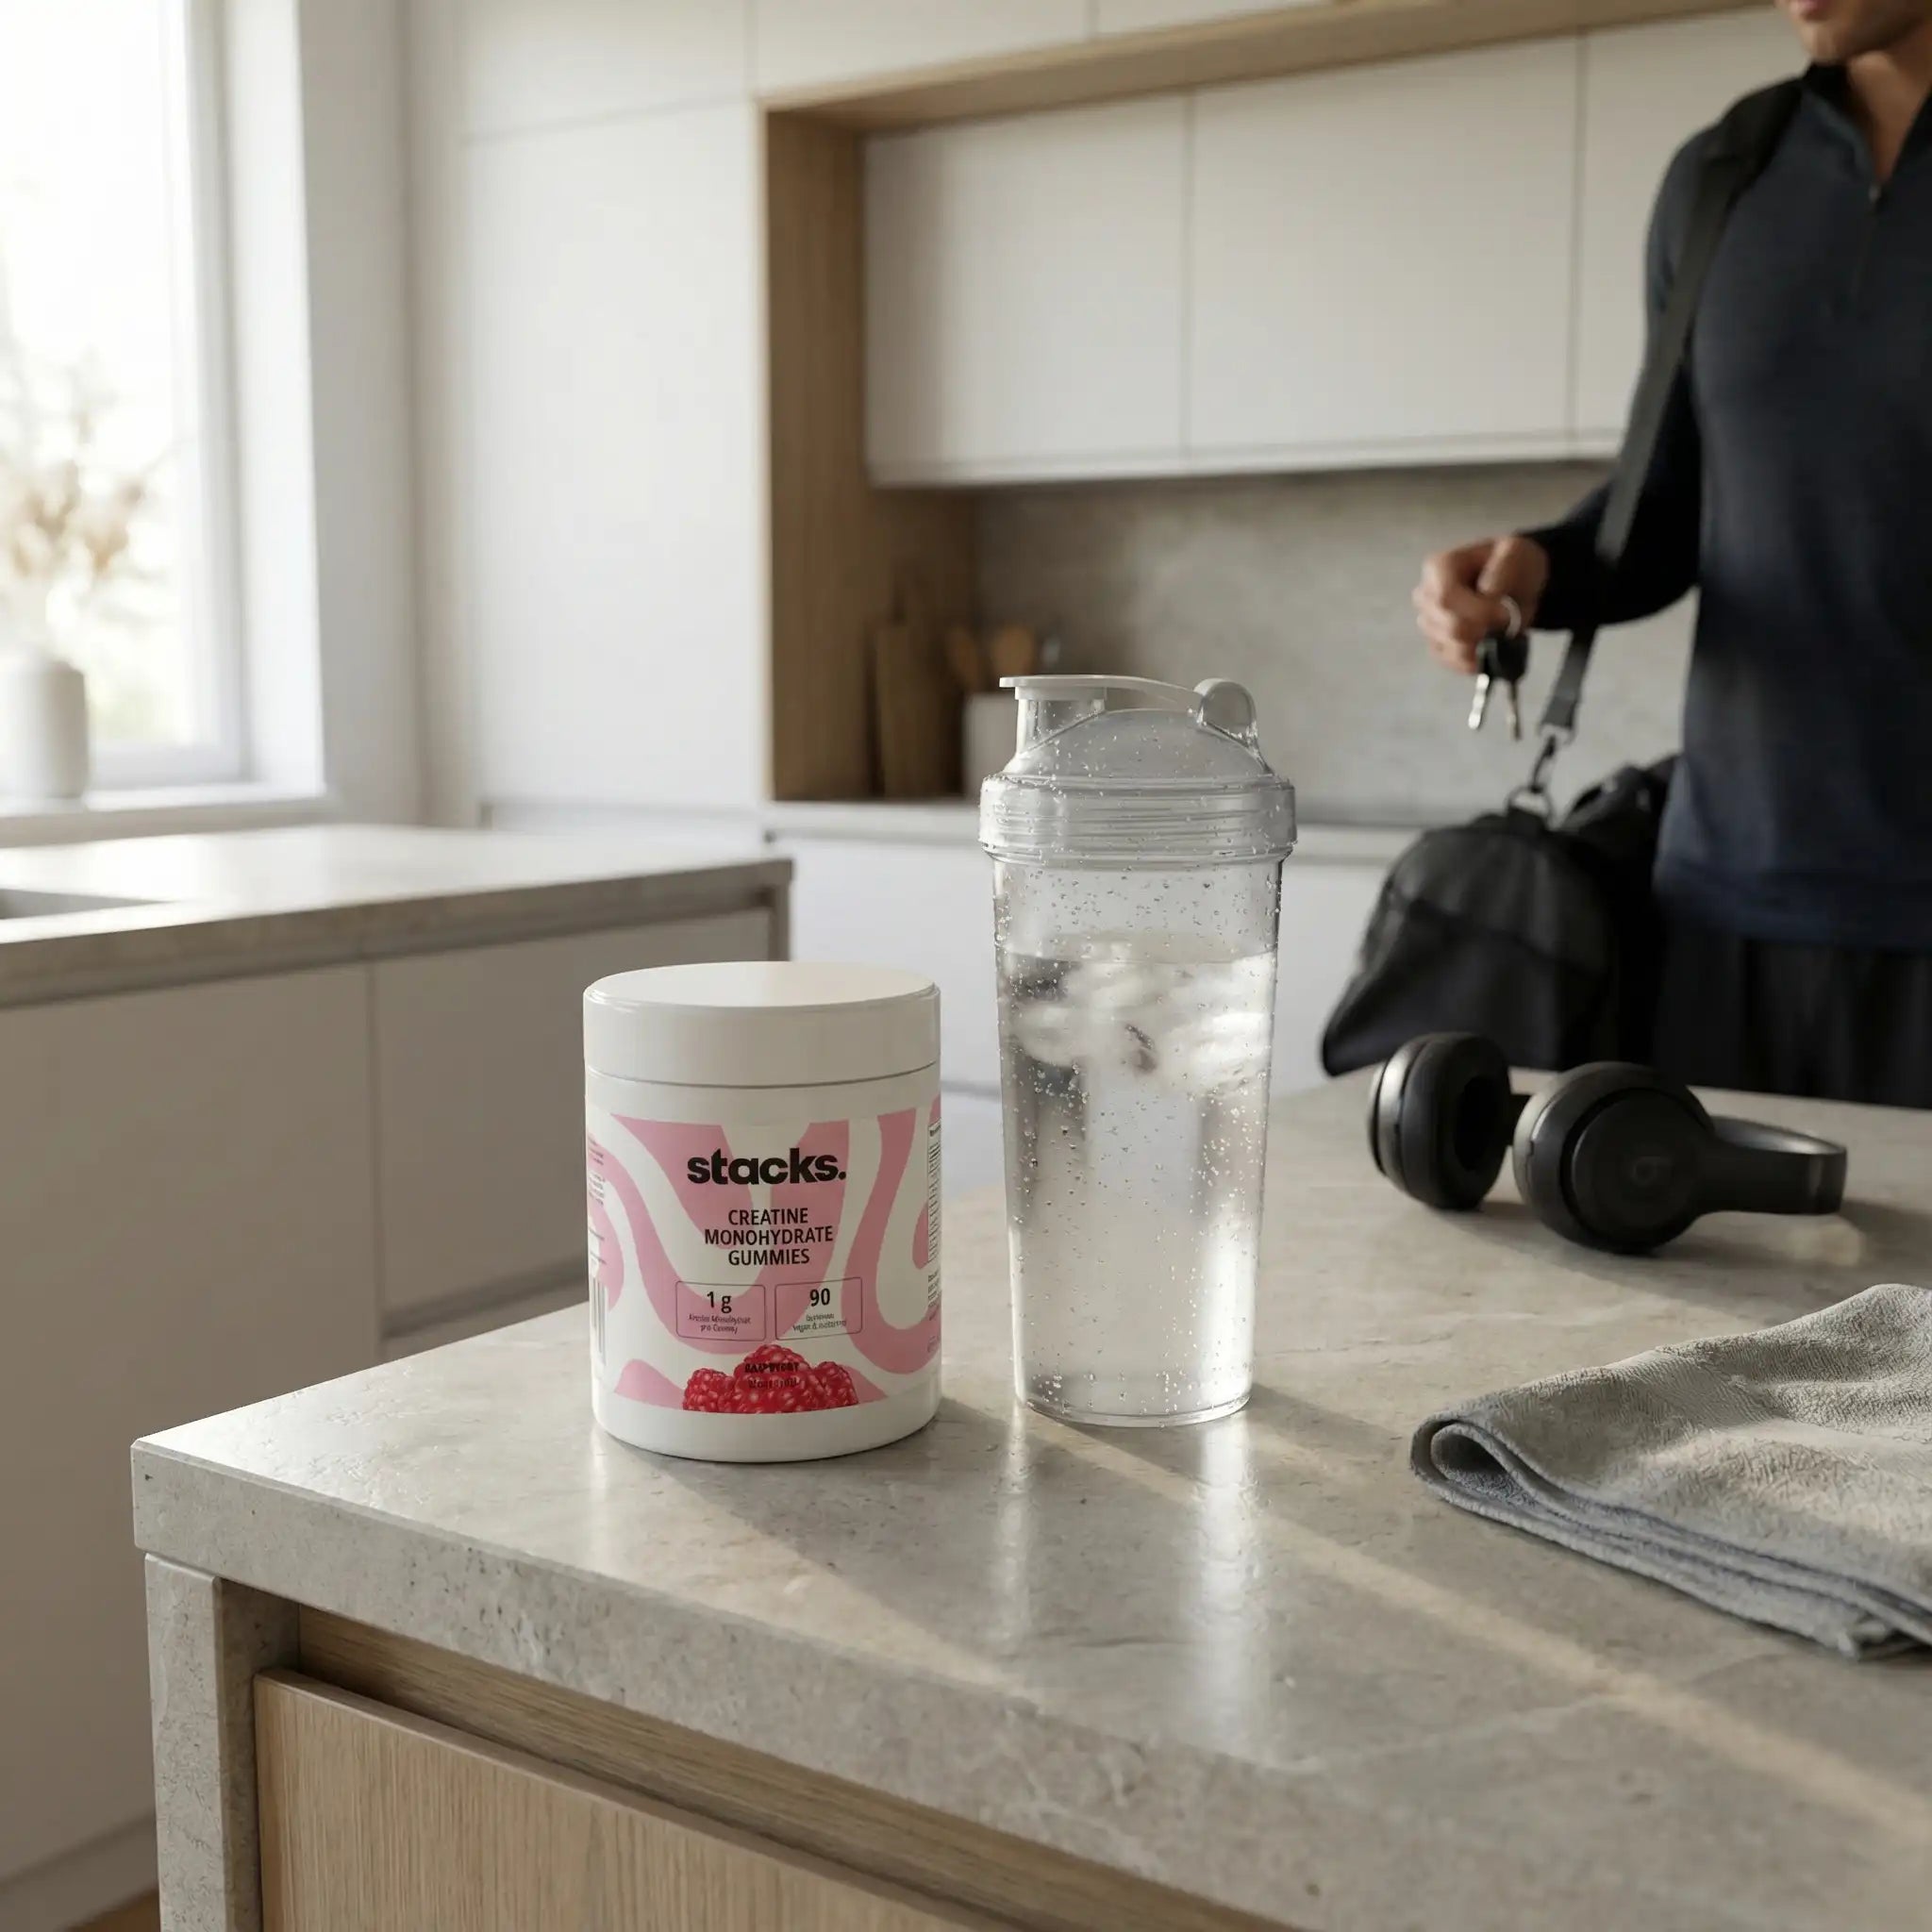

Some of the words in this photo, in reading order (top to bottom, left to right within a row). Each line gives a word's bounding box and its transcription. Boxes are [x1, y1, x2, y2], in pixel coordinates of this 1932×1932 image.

[687, 1147, 847, 1185] stacks.
[728, 1208, 808, 1225] CREATINE
[705, 1225, 834, 1245] MONOHYDRATE
[728, 1248, 810, 1266] GUMMIES
[707, 1291, 715, 1308] 1
[721, 1295, 733, 1314] g
[809, 1288, 831, 1307] 90
